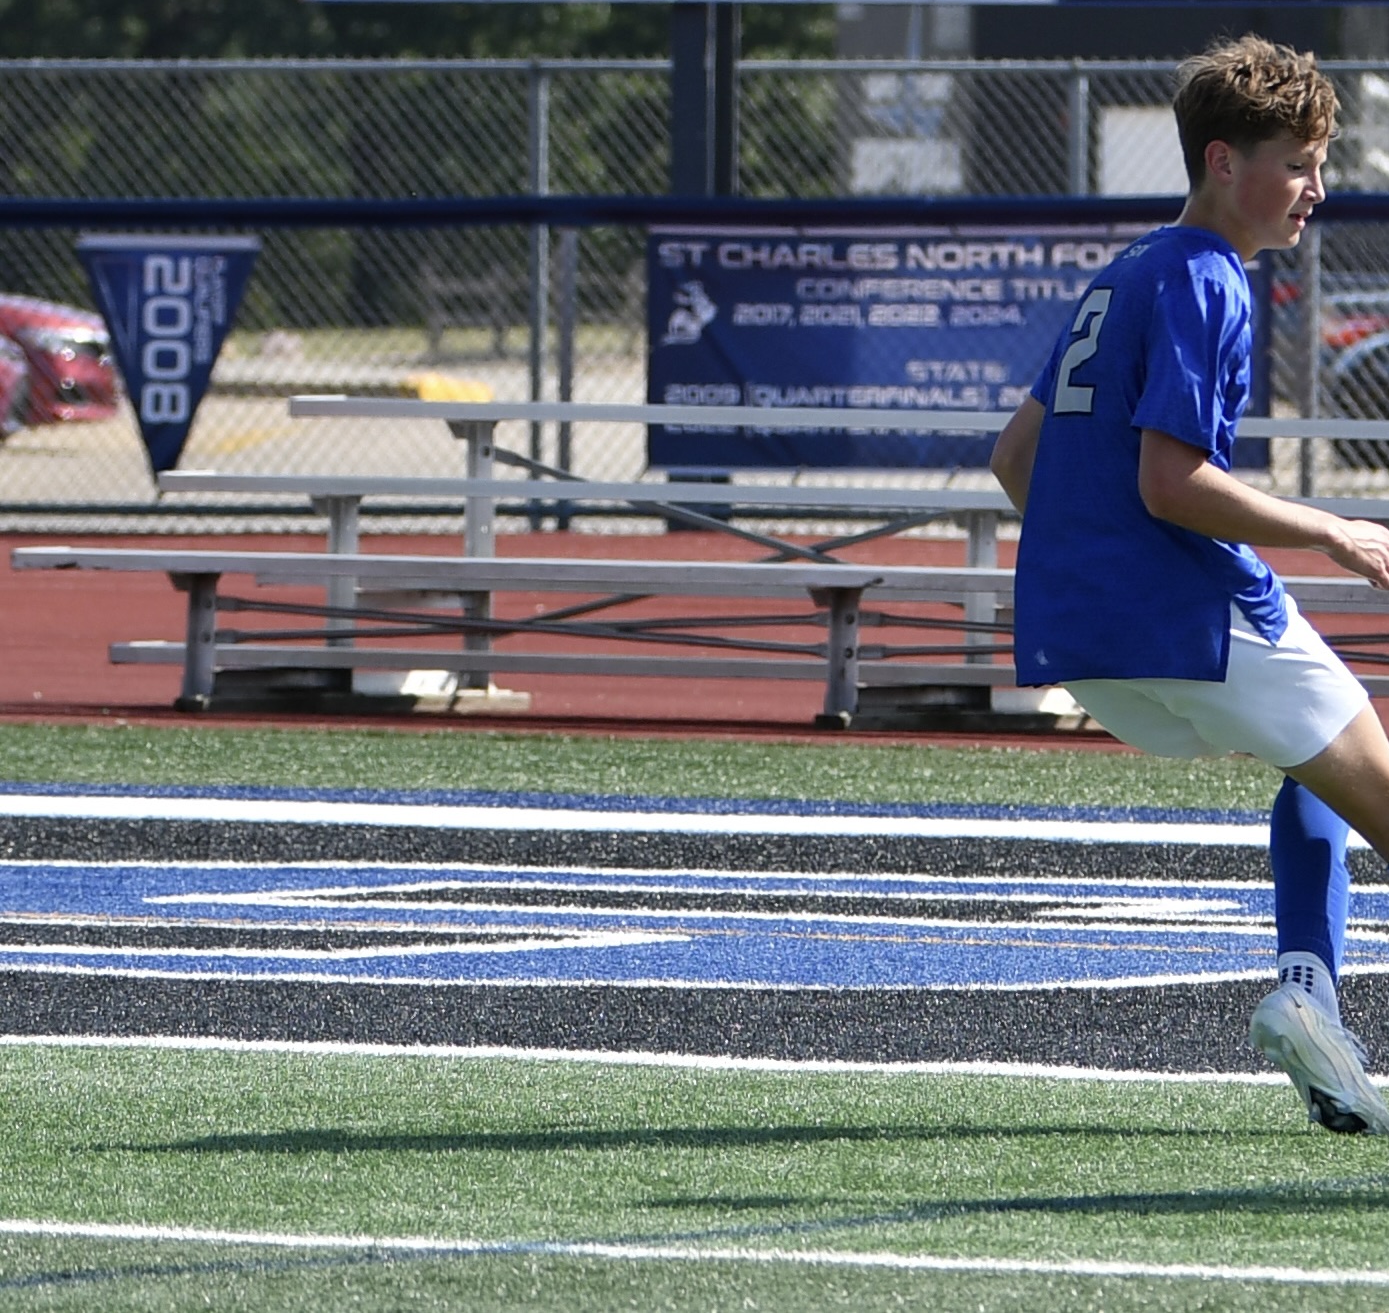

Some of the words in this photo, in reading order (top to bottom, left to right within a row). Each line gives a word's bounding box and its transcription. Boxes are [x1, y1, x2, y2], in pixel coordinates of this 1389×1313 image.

[658, 242, 710, 269] ST
[718, 242, 899, 271] CHARLES
[906, 242, 1044, 271] NORTH
[796, 278, 1002, 302] CONFERENCE
[141, 253, 192, 424] 2008
[1054, 289, 1112, 414] 2
